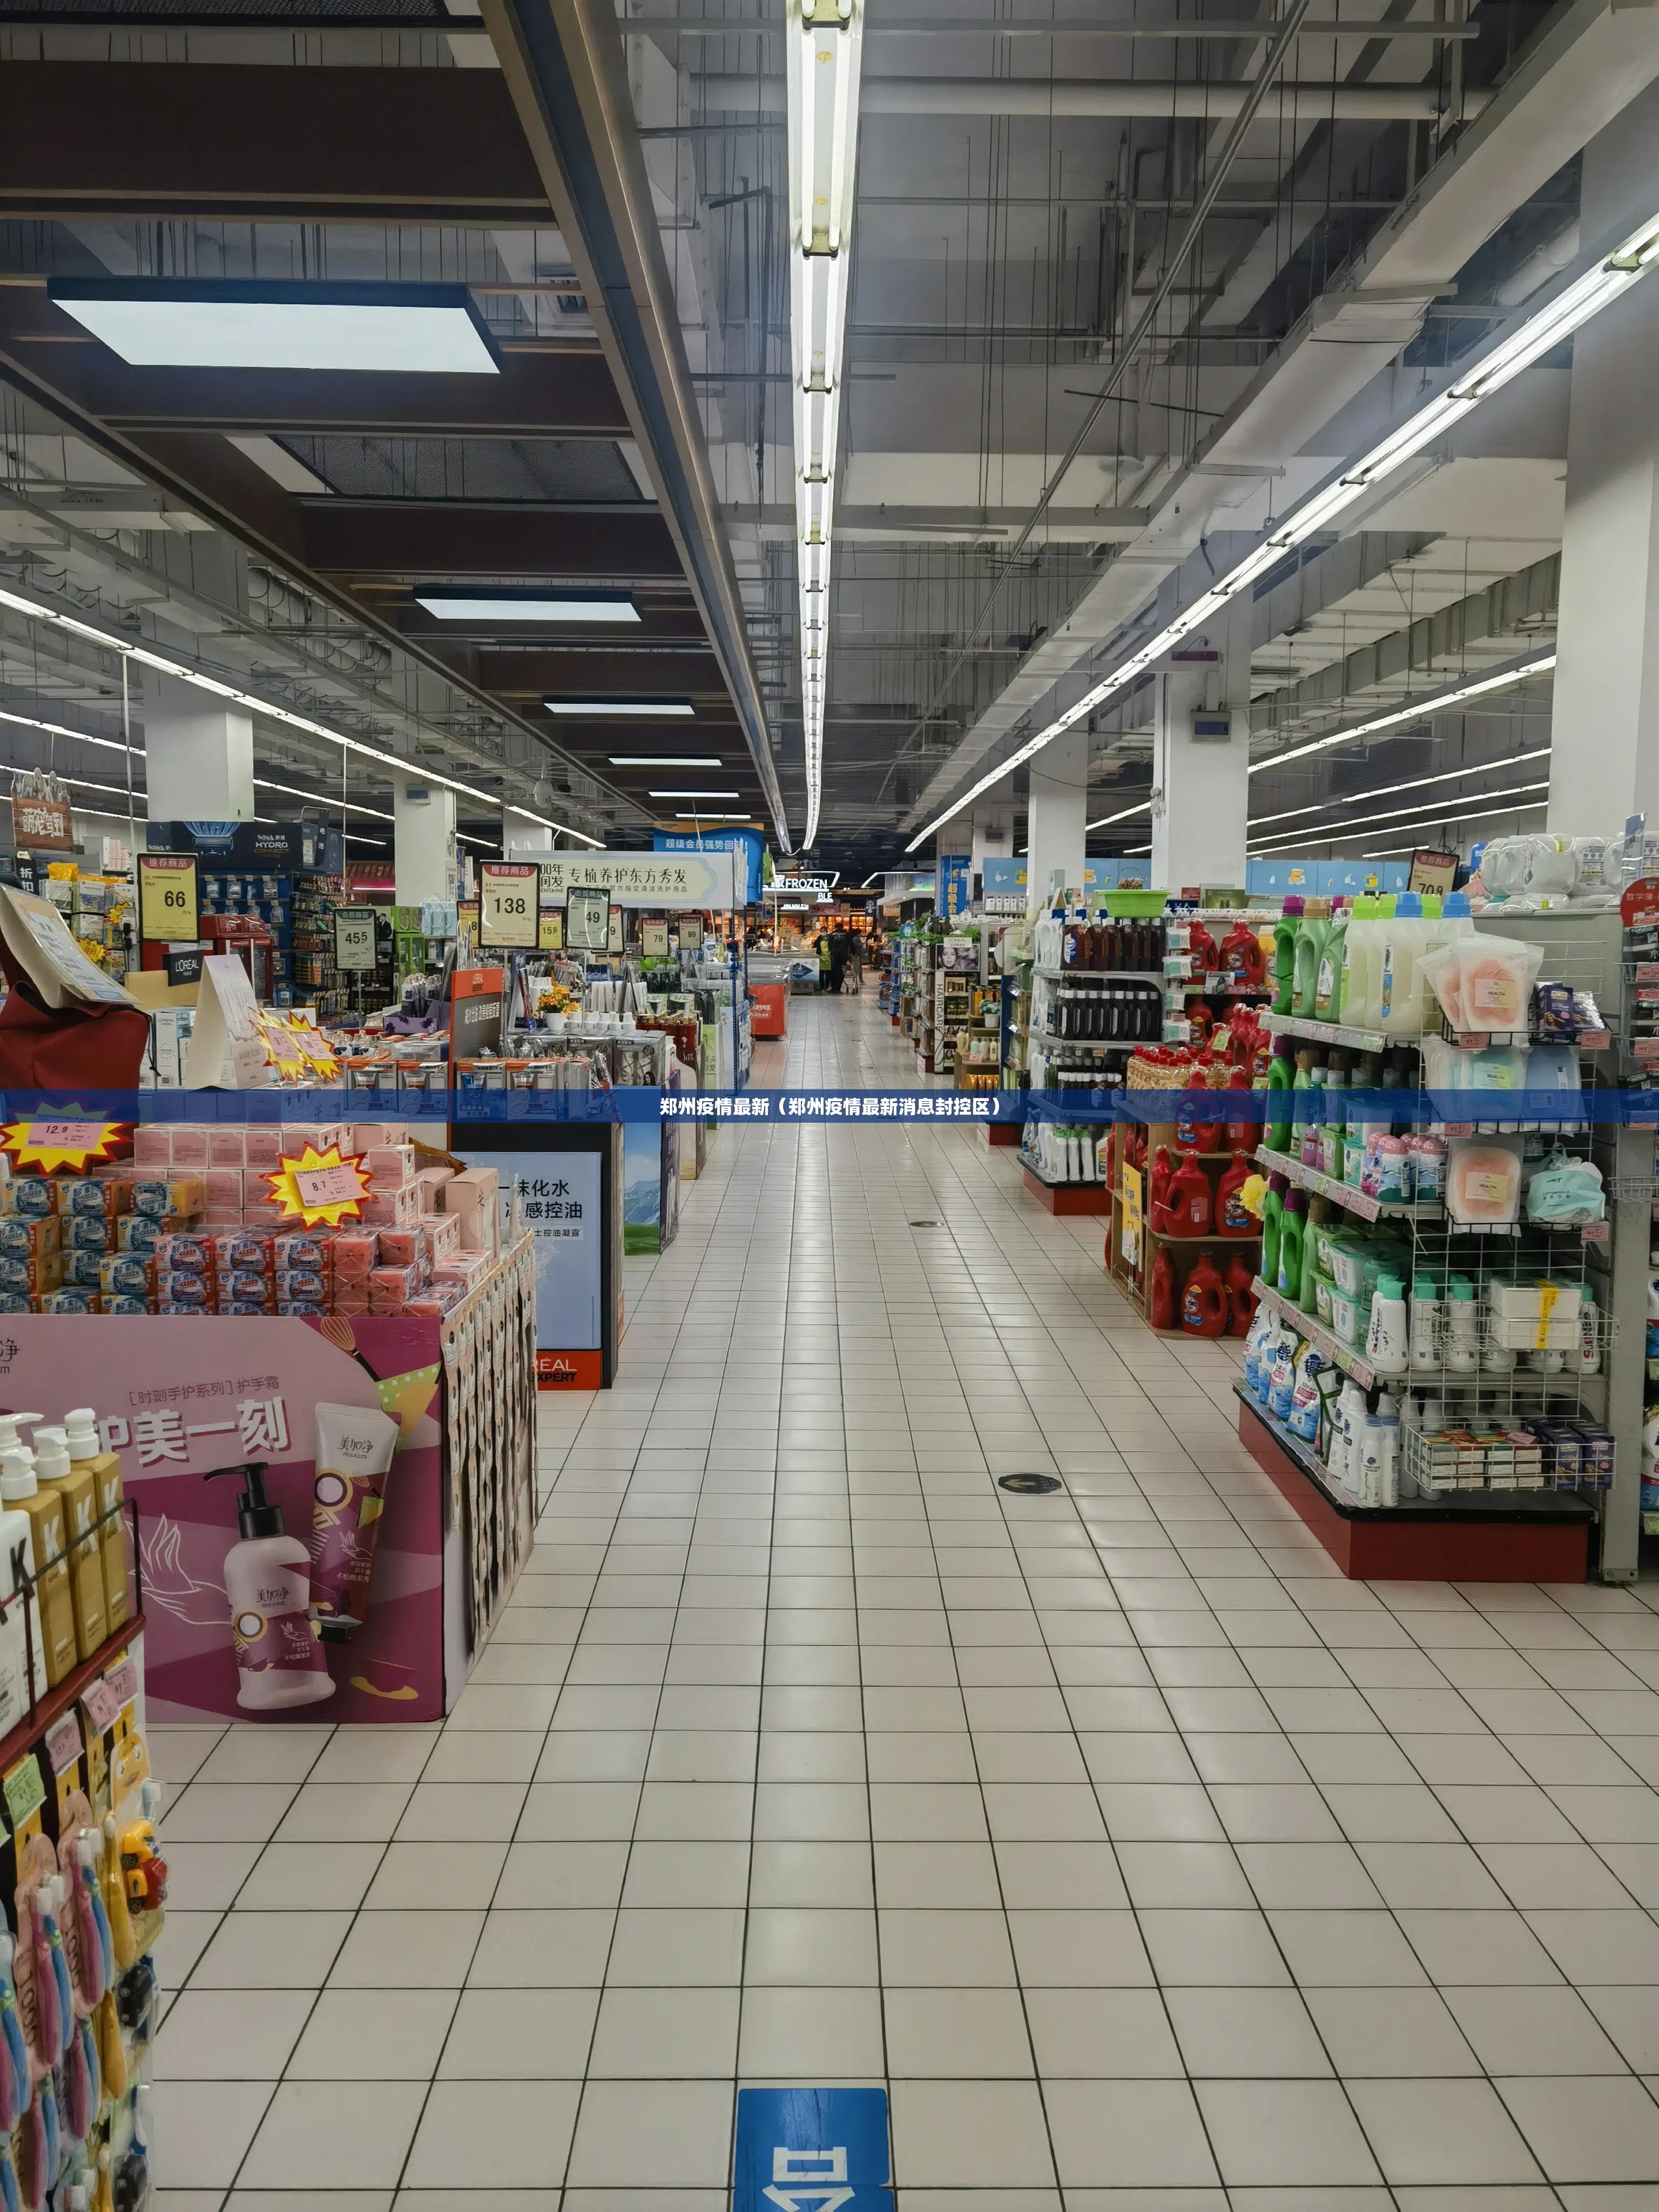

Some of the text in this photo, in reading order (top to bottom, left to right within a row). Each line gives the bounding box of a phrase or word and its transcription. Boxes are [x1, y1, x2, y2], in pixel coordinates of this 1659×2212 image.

[150, 858, 187, 867] 推荐商品
[491, 866, 529, 875] 推荐商品
[569, 867, 687, 885] 专植养护东方秀发
[787, 878, 827, 889] FROZEN
[164, 891, 186, 907] 66
[494, 898, 525, 914] 138
[586, 912, 600, 923] 49
[471, 921, 477, 930] 8
[45, 1125, 68, 1134] 12.9
[311, 1181, 326, 1191] 8.7
[528, 1229, 580, 1237] 士控油凝露
[104, 1475, 125, 1532] K
[77, 1494, 98, 1552] K
[44, 1515, 68, 1575] K
[10, 1536, 36, 1599] K
